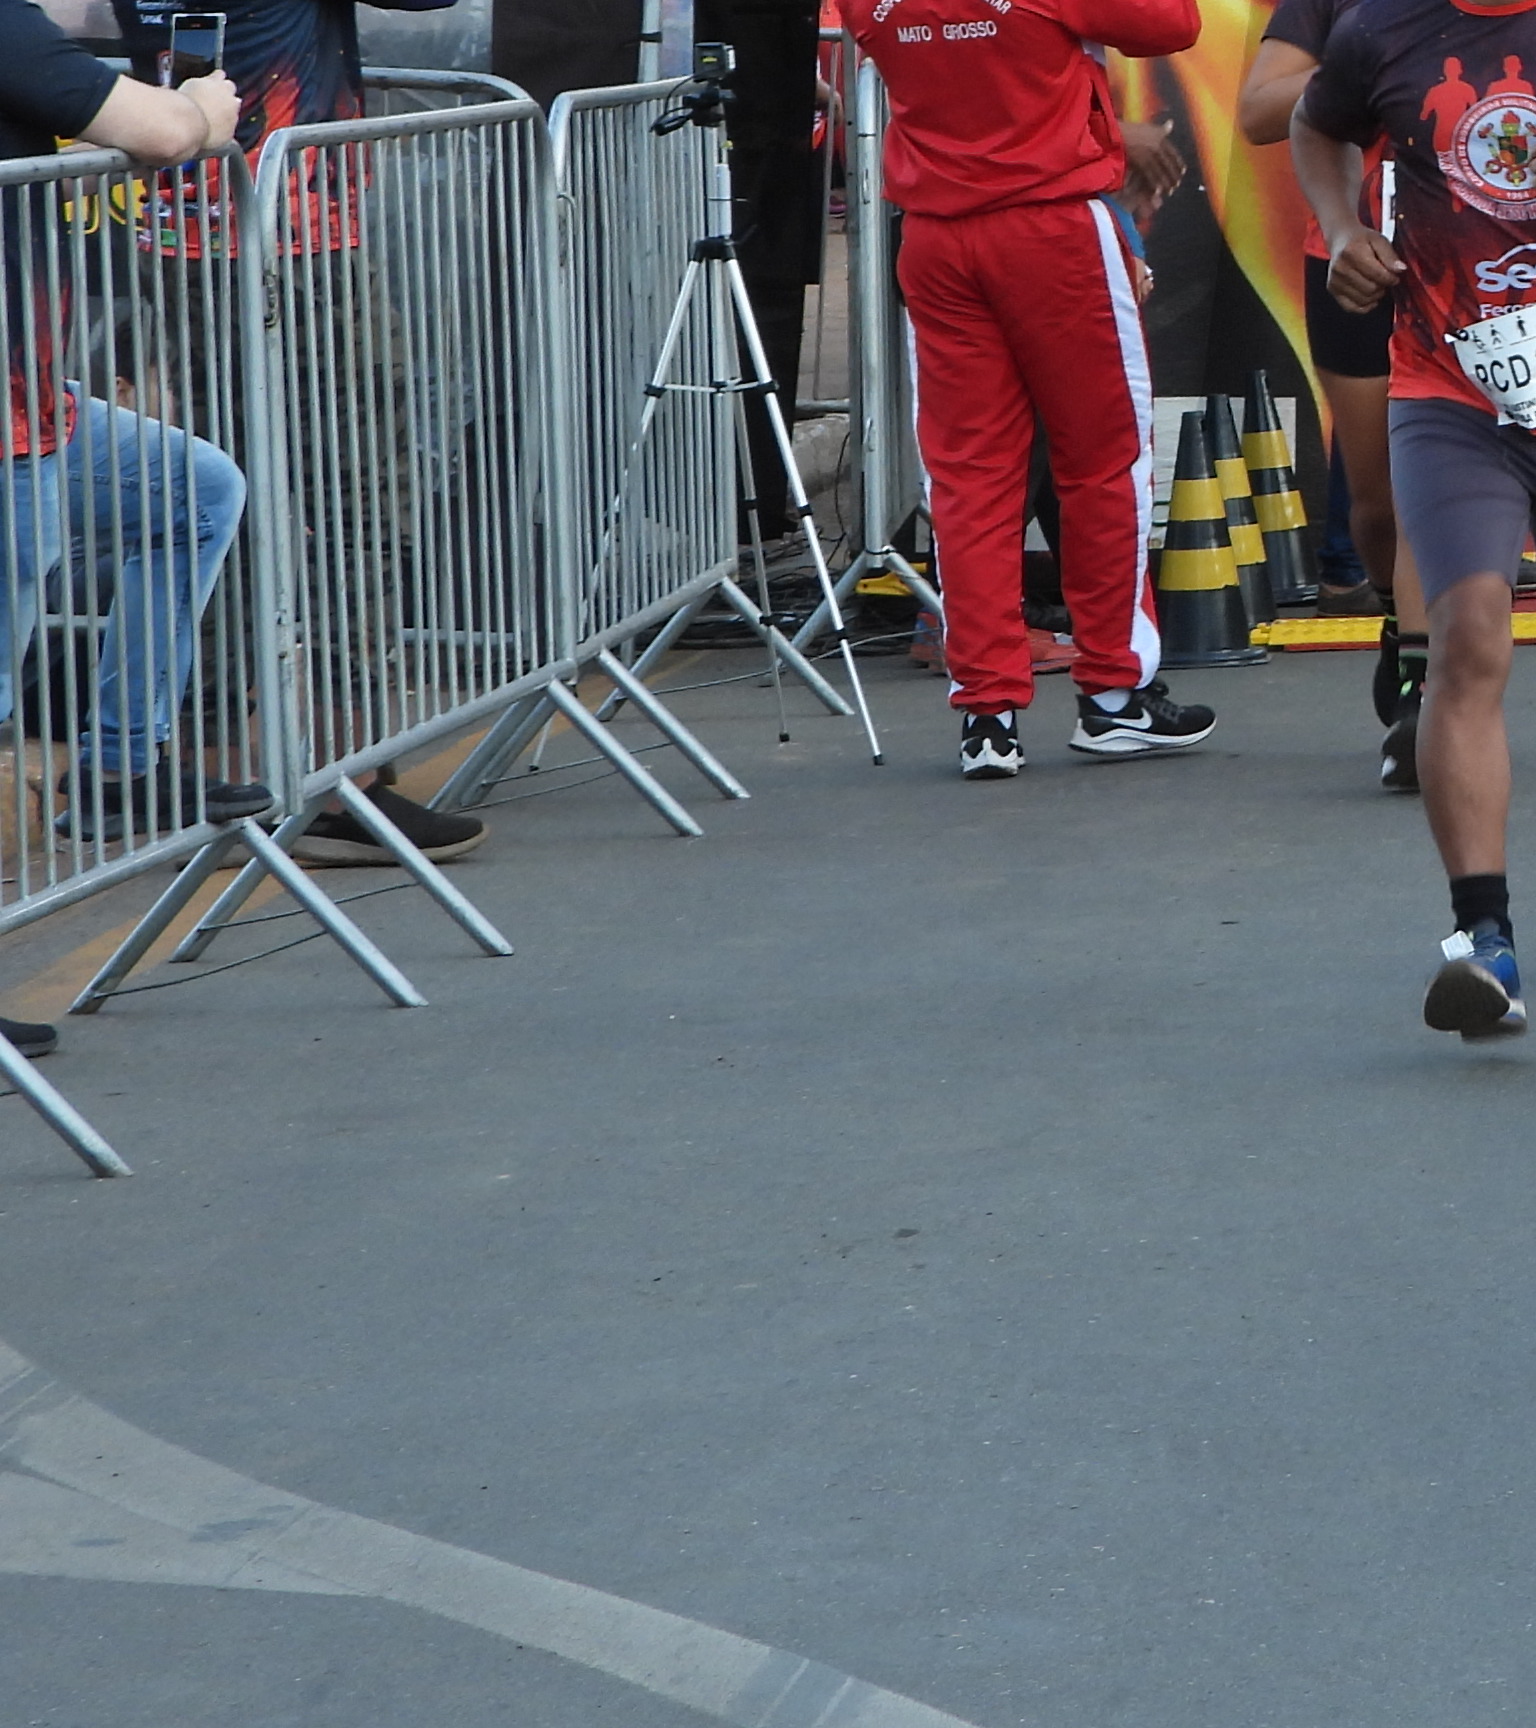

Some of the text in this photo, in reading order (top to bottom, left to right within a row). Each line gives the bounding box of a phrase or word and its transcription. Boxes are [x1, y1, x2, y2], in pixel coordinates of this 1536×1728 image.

[897, 20, 997, 43] MATO GROSSO
[1474, 354, 1531, 393] PCD
